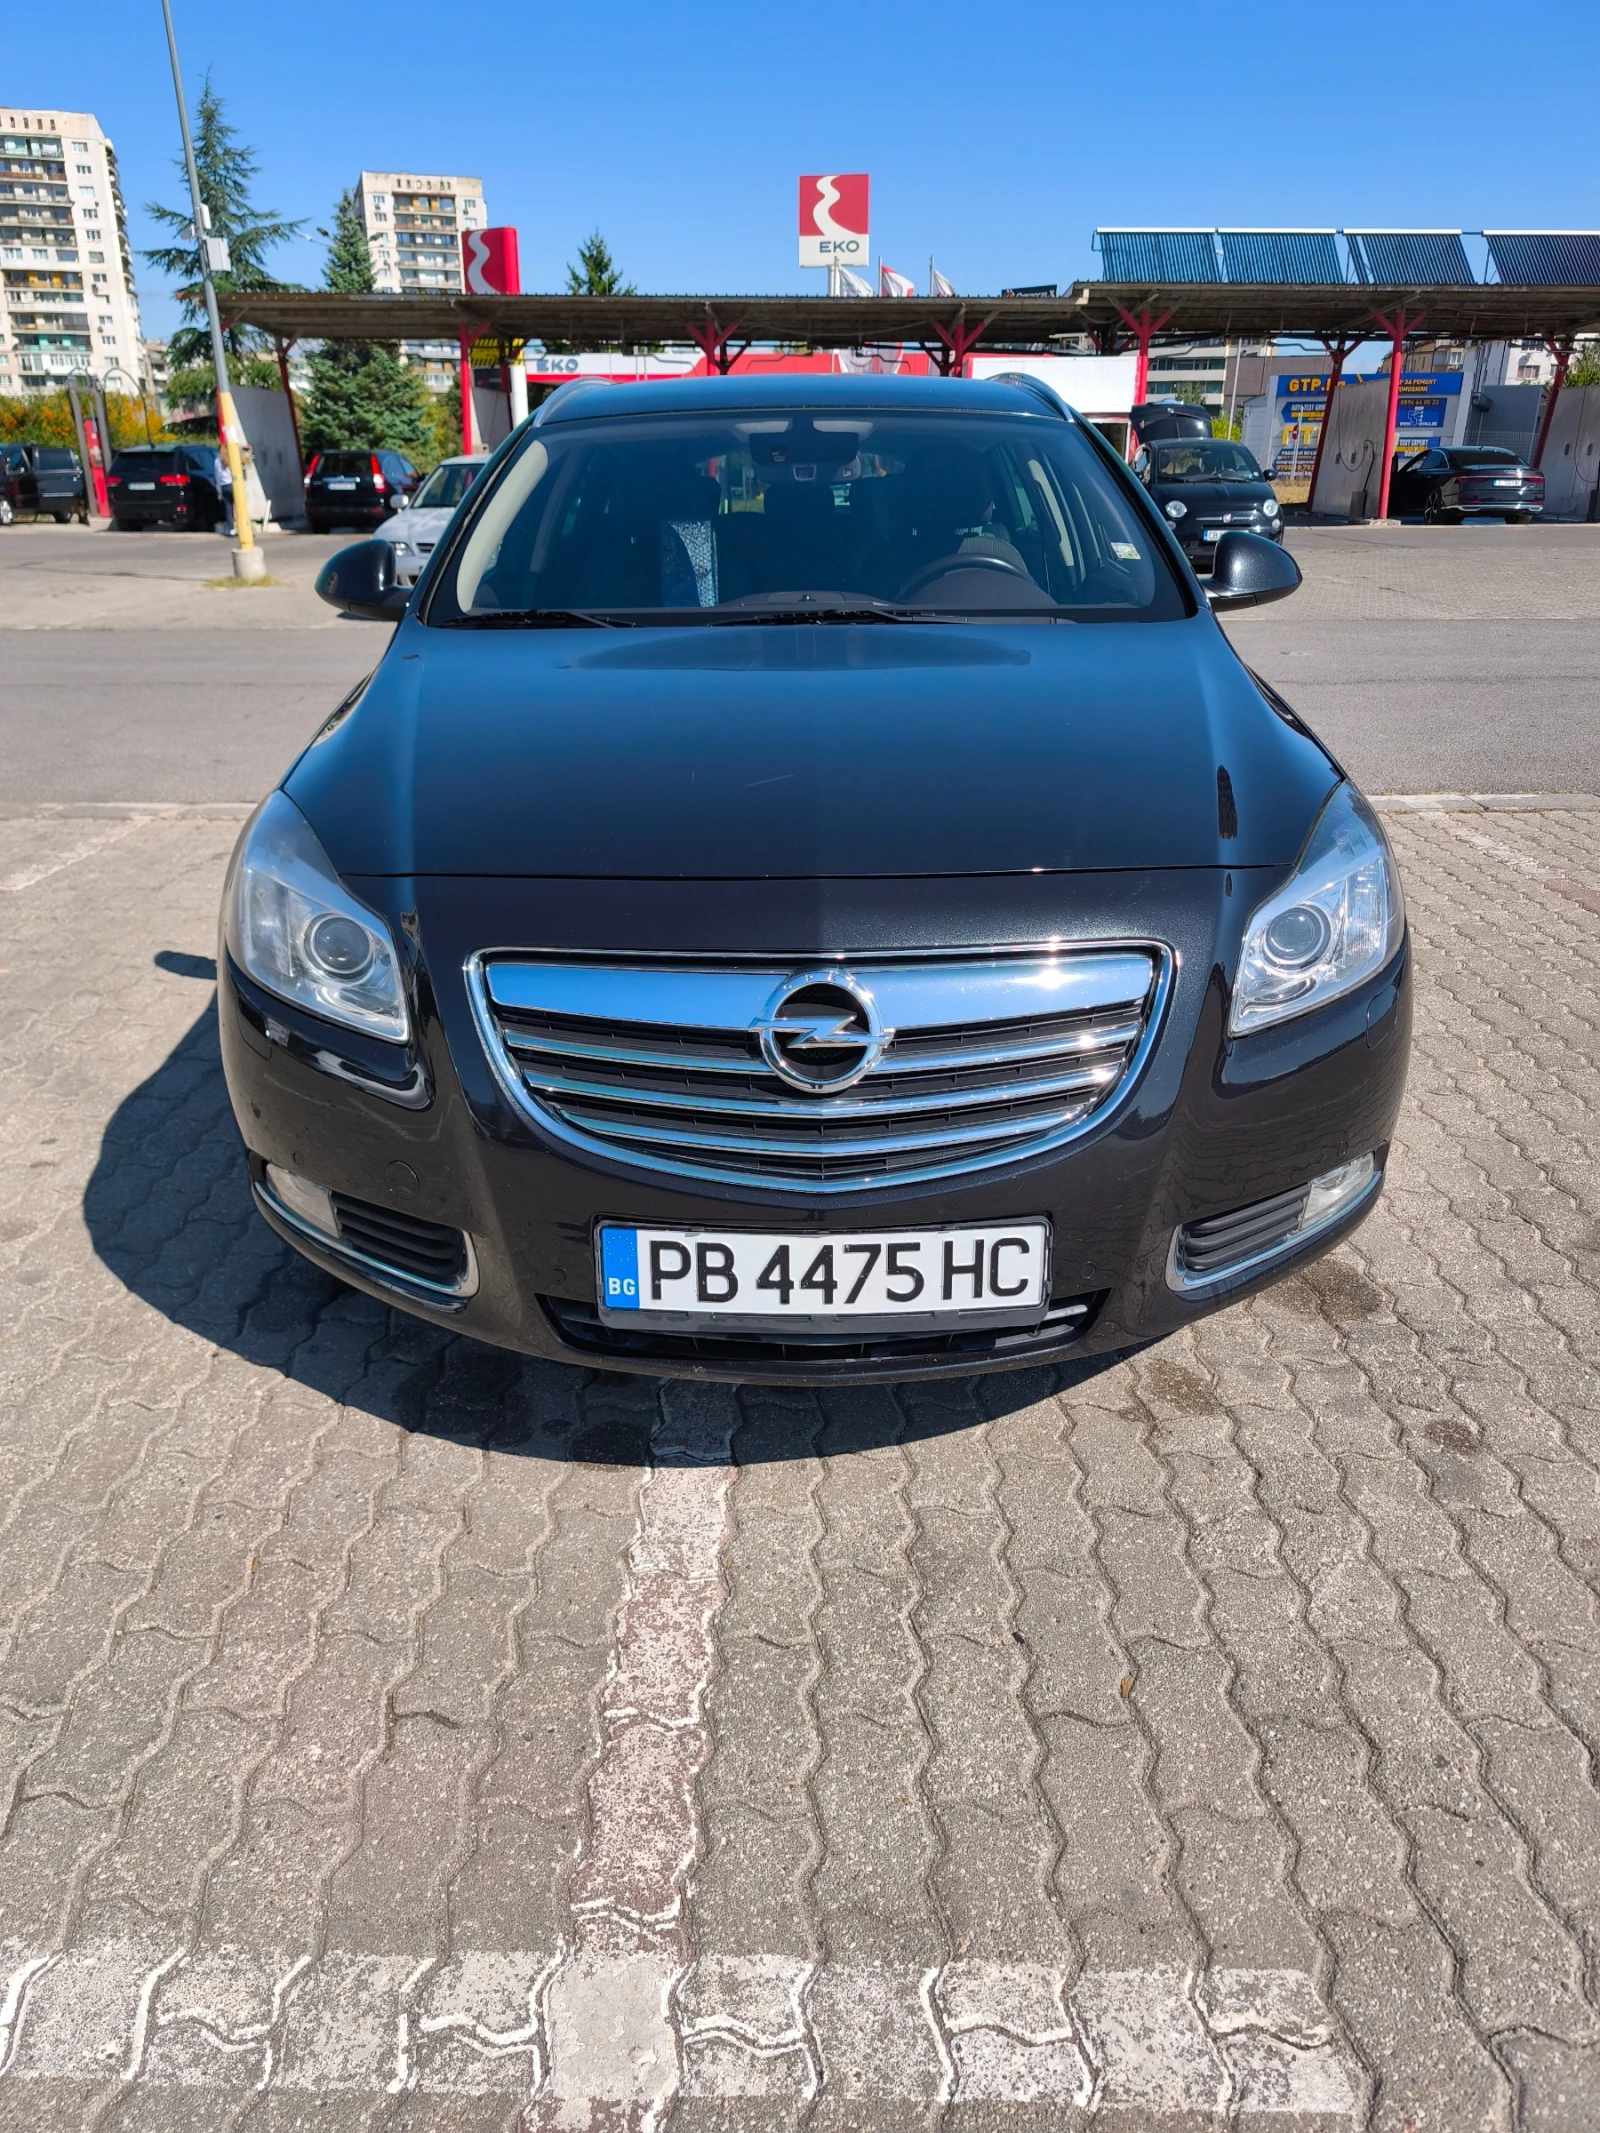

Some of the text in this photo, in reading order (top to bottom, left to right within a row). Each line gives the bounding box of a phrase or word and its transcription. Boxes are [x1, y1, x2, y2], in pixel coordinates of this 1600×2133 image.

[820, 240, 860, 253] EKO
[537, 359, 579, 372] EKO
[650, 1236, 1031, 1305] PB 4475 HC
[608, 1277, 636, 1296] BG
